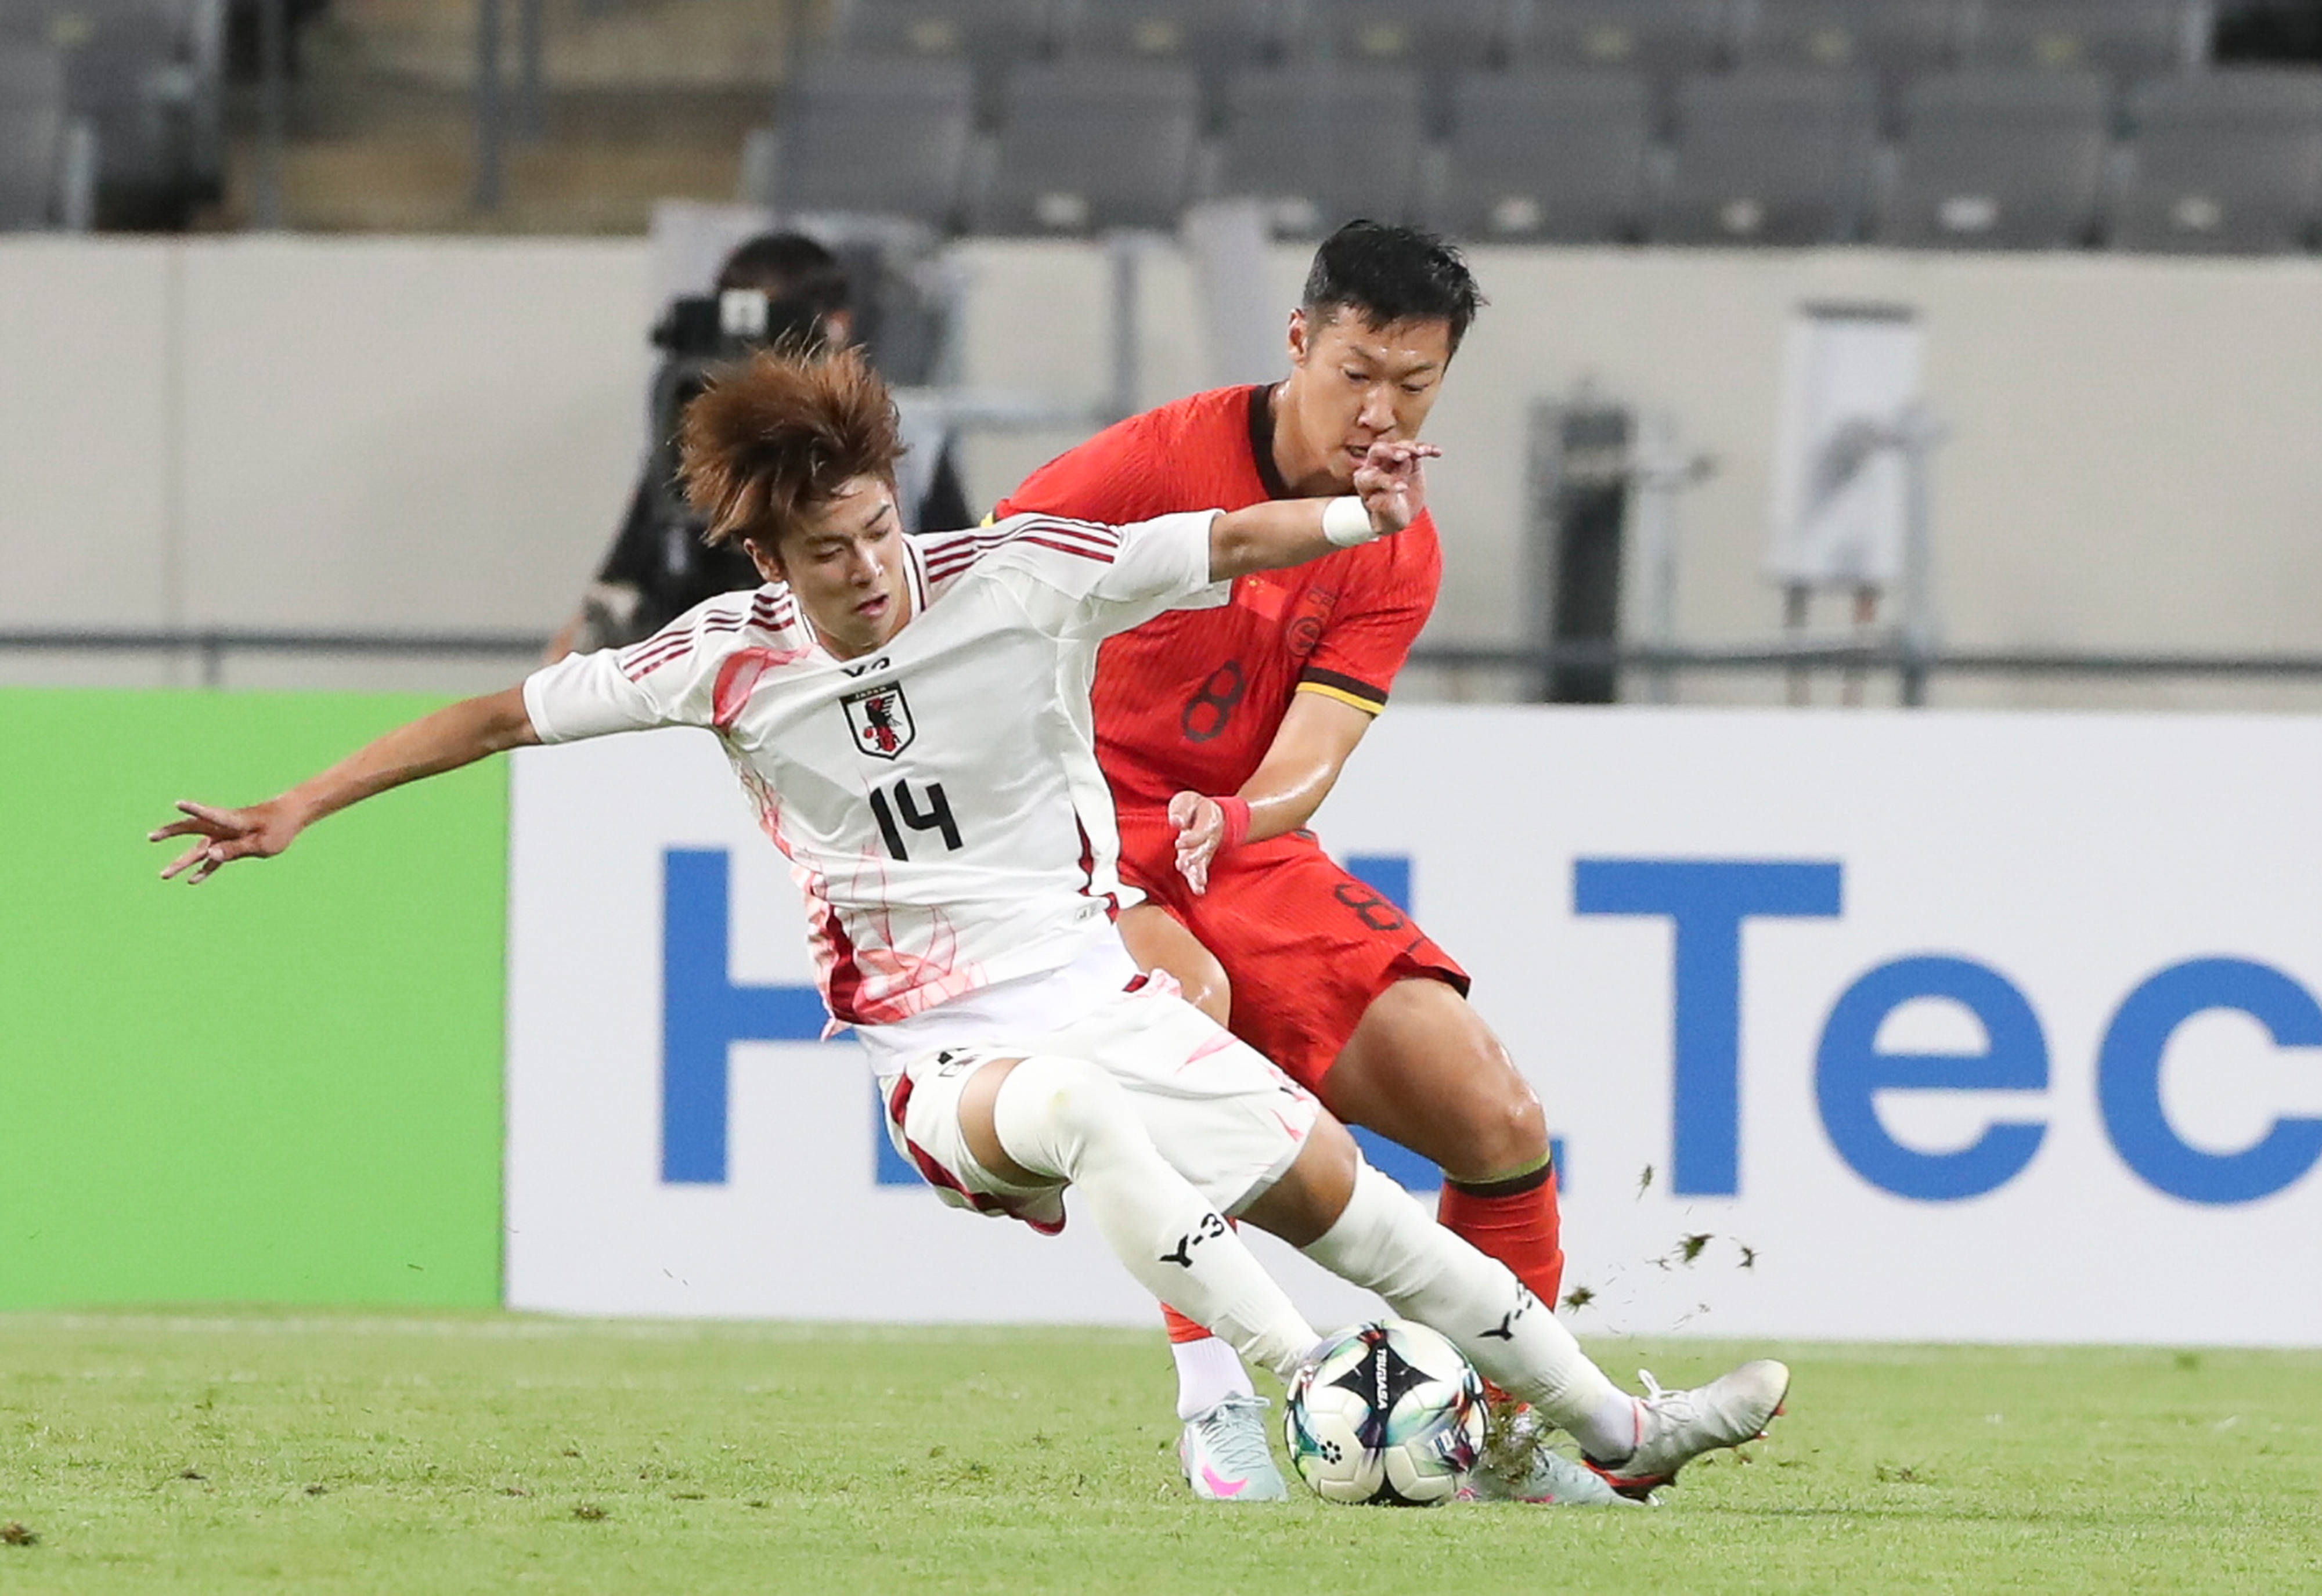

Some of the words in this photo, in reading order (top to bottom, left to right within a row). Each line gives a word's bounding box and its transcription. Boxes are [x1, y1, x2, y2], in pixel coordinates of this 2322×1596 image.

[1181, 659, 1246, 743] 8
[869, 778, 964, 862] 14
[1334, 883, 1404, 930] 8
[1159, 1212, 1225, 1268] Y-3
